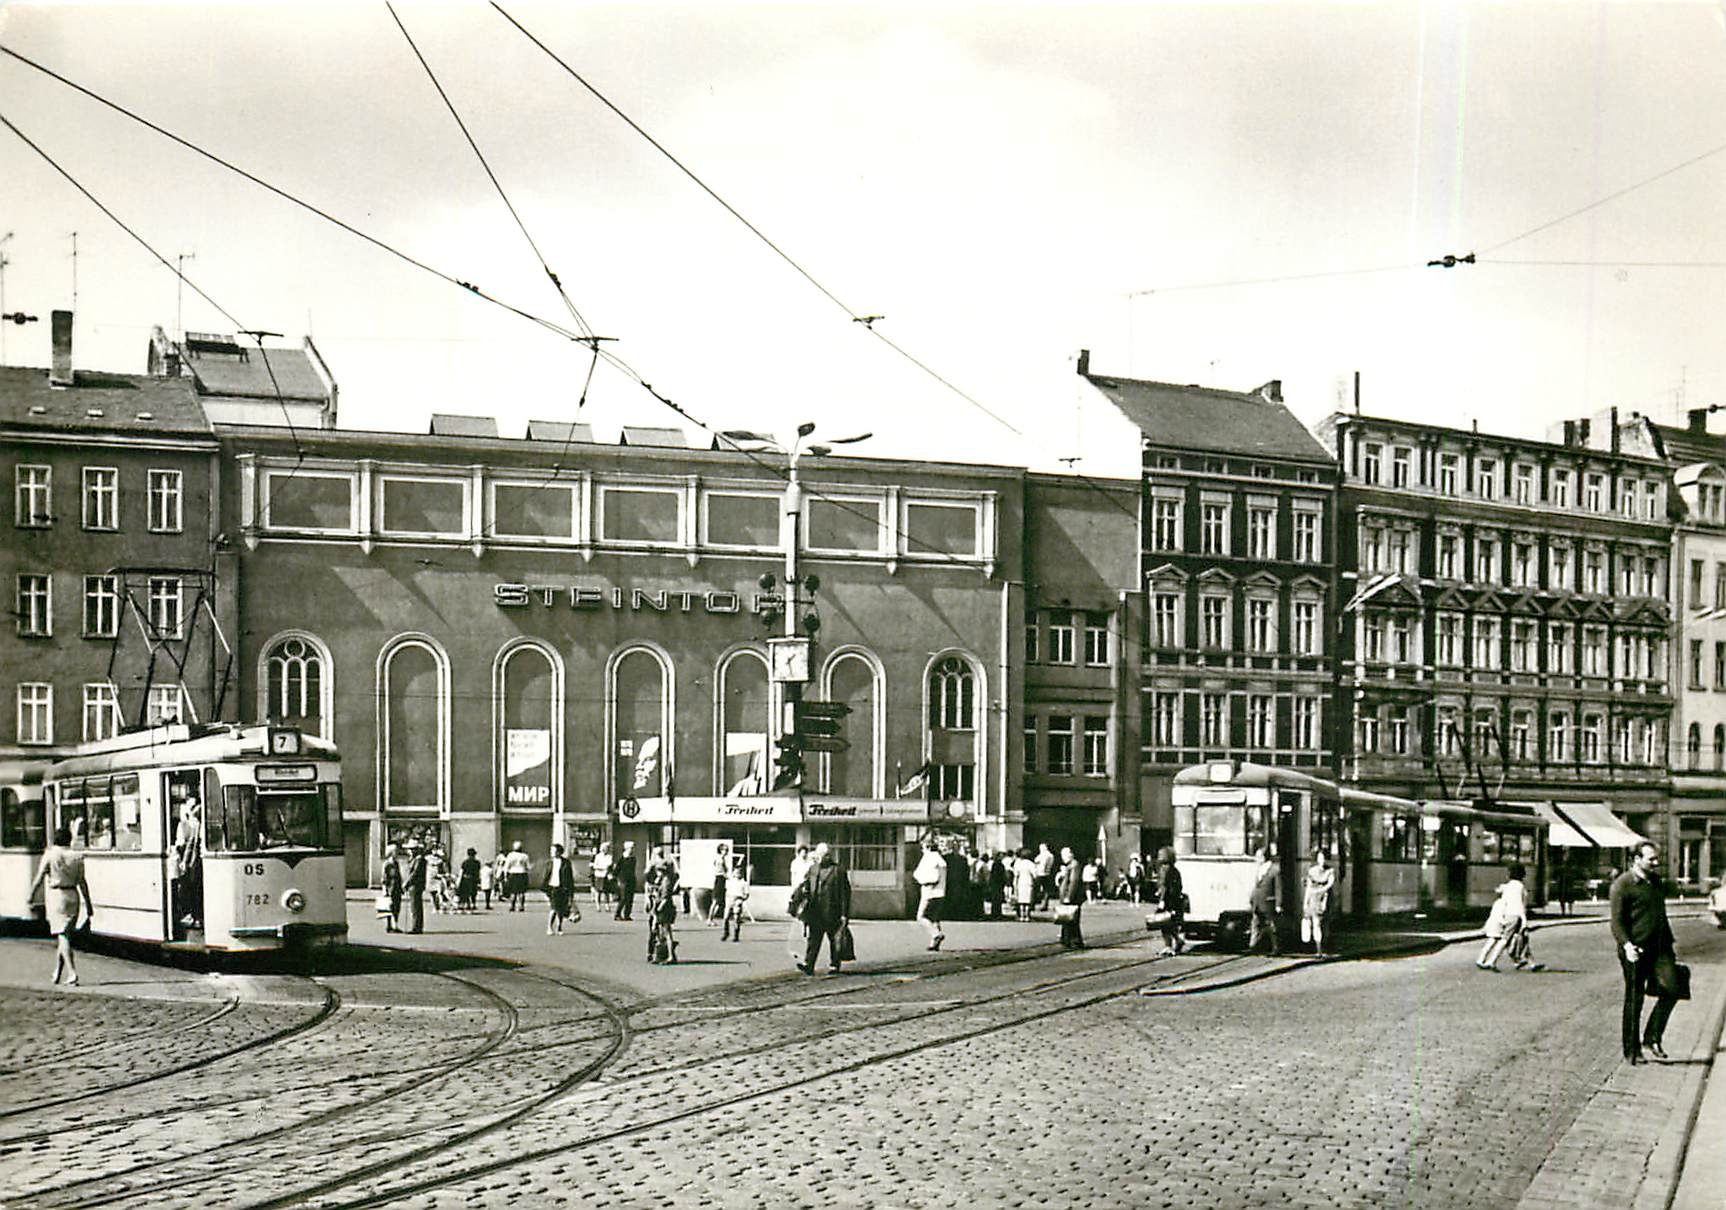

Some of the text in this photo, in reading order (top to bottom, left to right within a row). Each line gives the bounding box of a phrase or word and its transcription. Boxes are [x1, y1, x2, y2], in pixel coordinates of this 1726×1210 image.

[494, 583, 785, 613] STEINTOR
[278, 736, 287, 748] 7
[508, 786, 550, 802] МИР
[725, 804, 774, 816] Freiheit
[808, 804, 857, 816] Freiheit
[247, 894, 269, 905] 782
